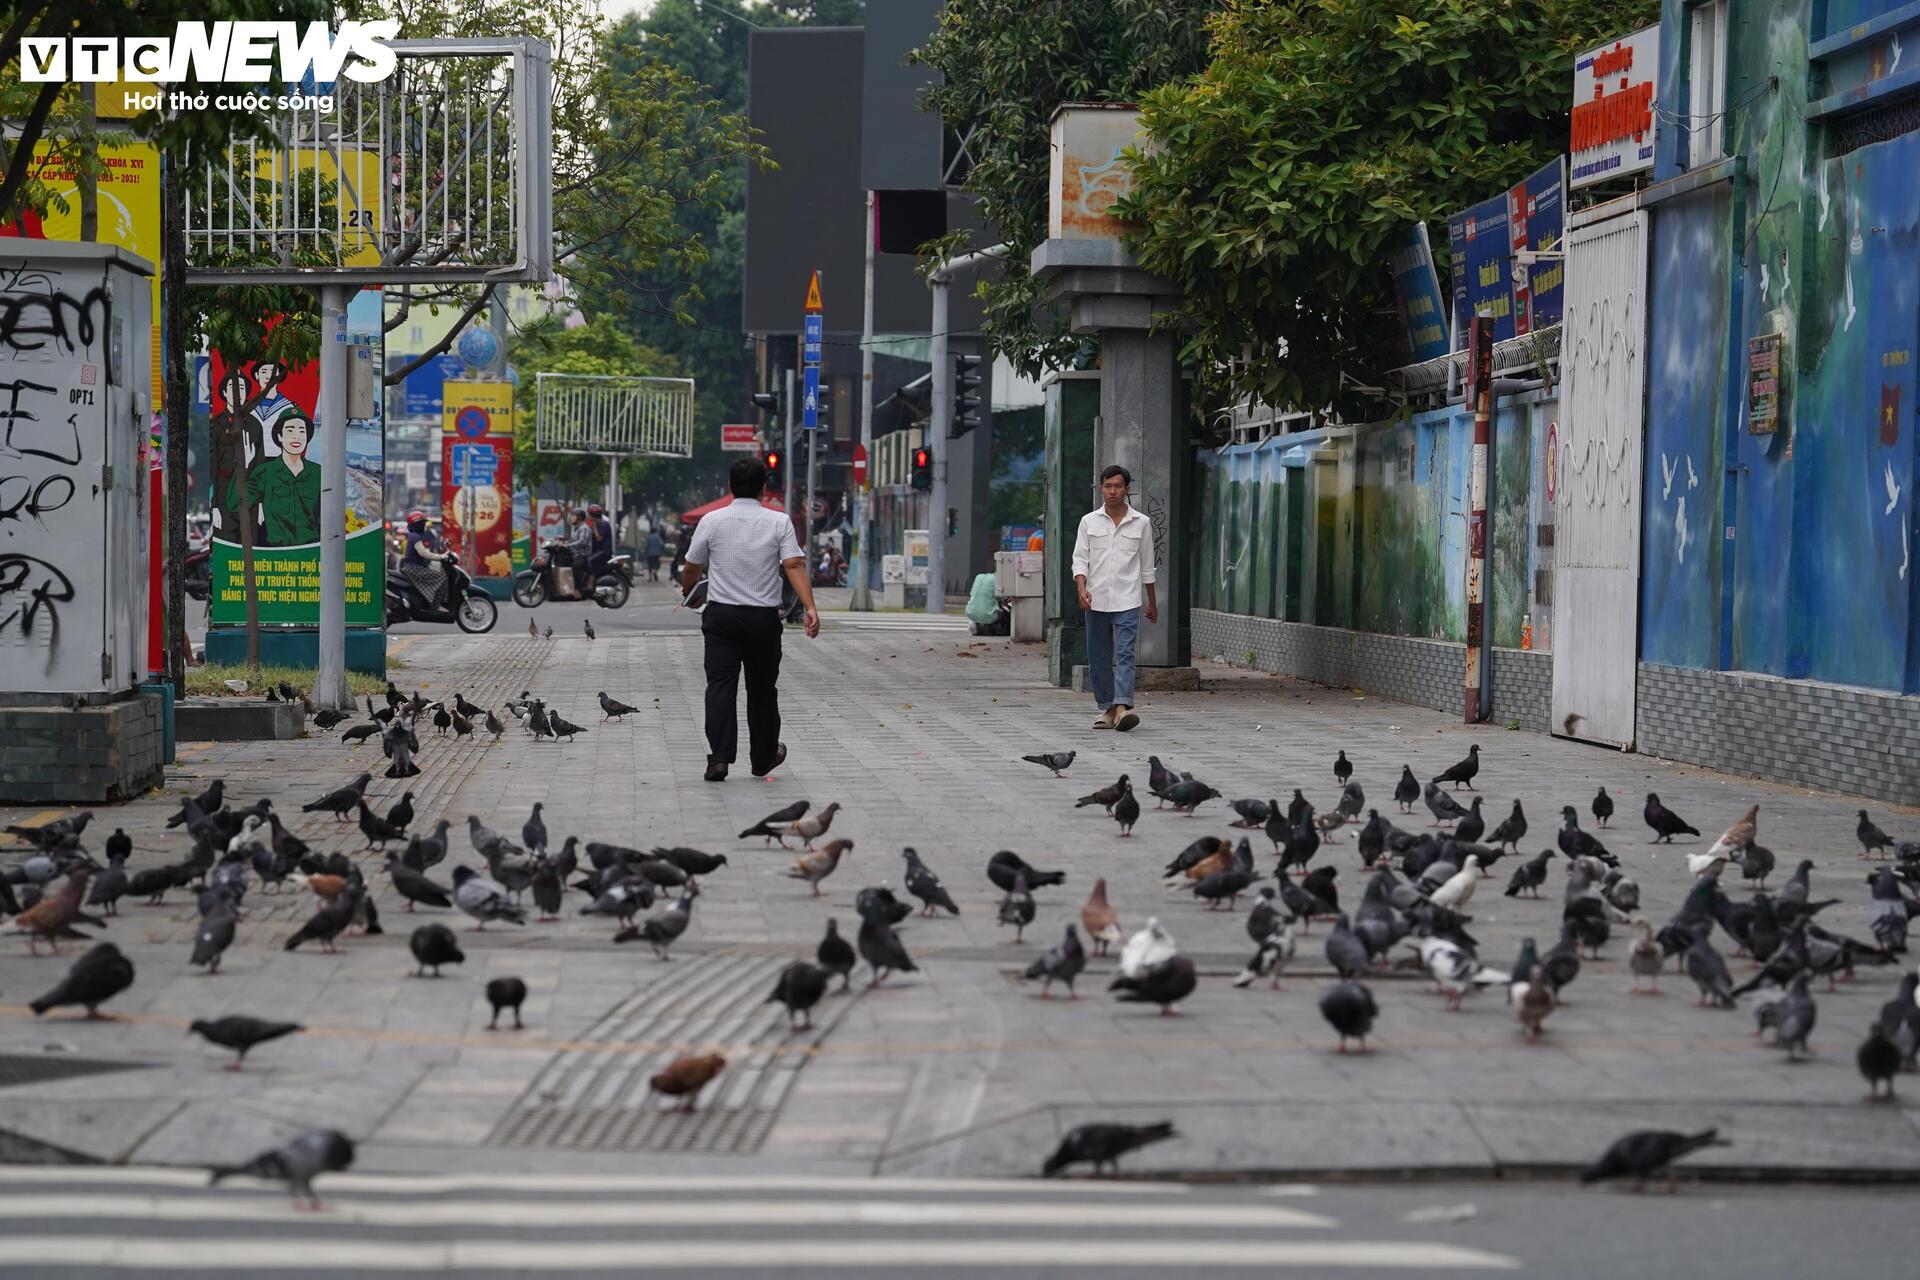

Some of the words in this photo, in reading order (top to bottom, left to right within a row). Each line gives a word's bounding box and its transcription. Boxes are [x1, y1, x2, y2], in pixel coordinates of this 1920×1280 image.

[130, 159, 144, 169] XVI
[228, 560, 245, 572] THA
[230, 573, 245, 587] PHÁ
